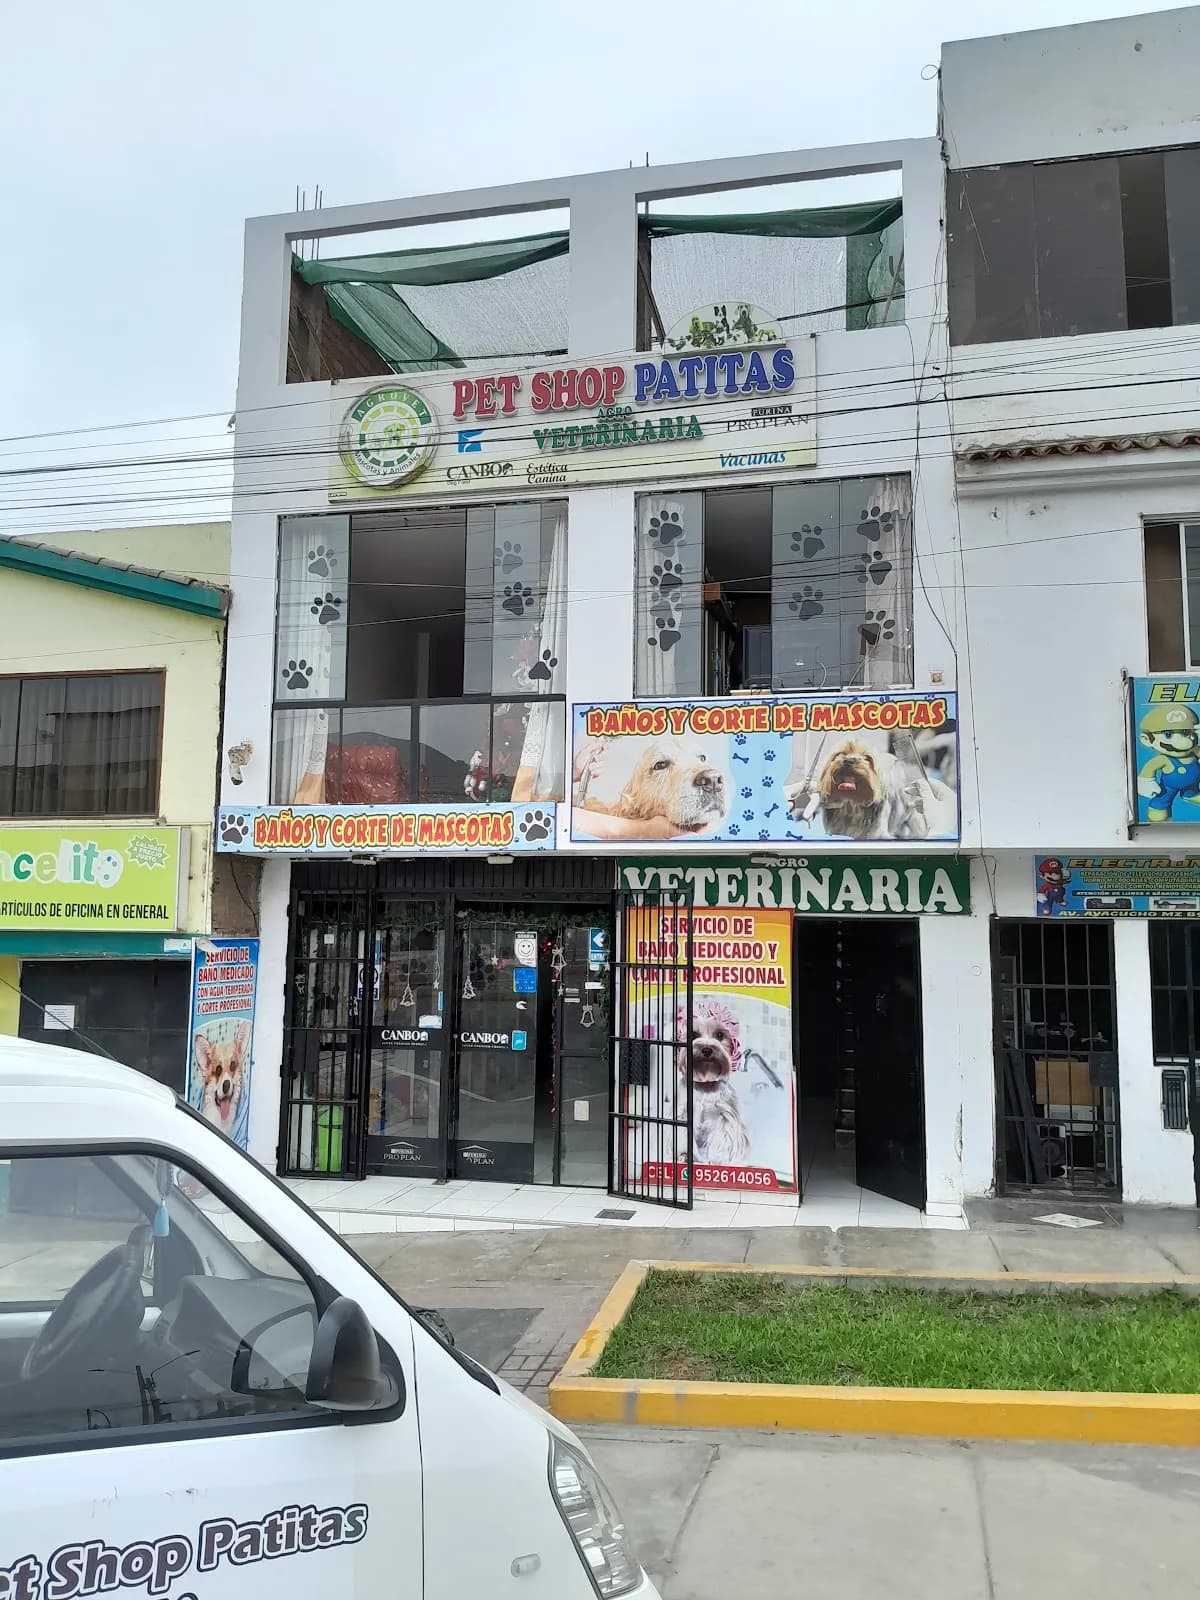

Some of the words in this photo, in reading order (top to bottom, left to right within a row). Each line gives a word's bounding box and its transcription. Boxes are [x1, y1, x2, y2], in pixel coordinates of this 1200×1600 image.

[452, 376, 521, 420] PET
[530, 366, 625, 412] SHOP
[634, 348, 796, 404] PATITAS
[356, 391, 428, 418] AGROVET
[597, 405, 633, 420] AGRO
[752, 406, 792, 416] PURINA
[532, 414, 703, 450] VETERINARIA
[720, 452, 785, 468] Vacunas
[446, 463, 502, 480] CANBO
[527, 473, 568, 484] Canina
[1149, 683, 1200, 703] EL
[587, 704, 667, 737] BAÑOS
[669, 707, 689, 735] Y
[690, 705, 770, 734] CORTE
[773, 703, 807, 732] DE
[810, 698, 947, 731] MASCOTAS
[254, 808, 314, 849] BAÑOS
[315, 814, 330, 848] Y
[330, 813, 389, 848] CORTE
[390, 812, 416, 847] DE
[417, 810, 514, 847] MASCOTAS
[623, 867, 963, 912] VETERINARIA
[0, 900, 47, 917] RTÍCULOS
[50, 903, 62, 917] DE
[65, 903, 103, 918] OFICINA
[106, 904, 120, 919] EN
[123, 904, 169, 920] GENERAL
[662, 917, 728, 935] SERVICIO
[733, 918, 753, 935] DE
[206, 948, 238, 962] SERVICIO
[240, 947, 249, 960] DE
[685, 941, 763, 959] MEDICADO
[768, 943, 777, 960] Y
[220, 966, 254, 980] MEDICADO
[632, 967, 677, 984] CORTE
[197, 987, 208, 998] CON
[210, 985, 223, 997] AGUA
[202, 1001, 218, 1013] CORTE
[220, 998, 252, 1011] PROFESIONAL
[381, 1030, 421, 1041] CANBO
[461, 1032, 501, 1044] CANBO
[695, 1168, 771, 1186] 952614056
[45, 1534, 193, 1599] Shop
[197, 1503, 369, 1572] Patitas
